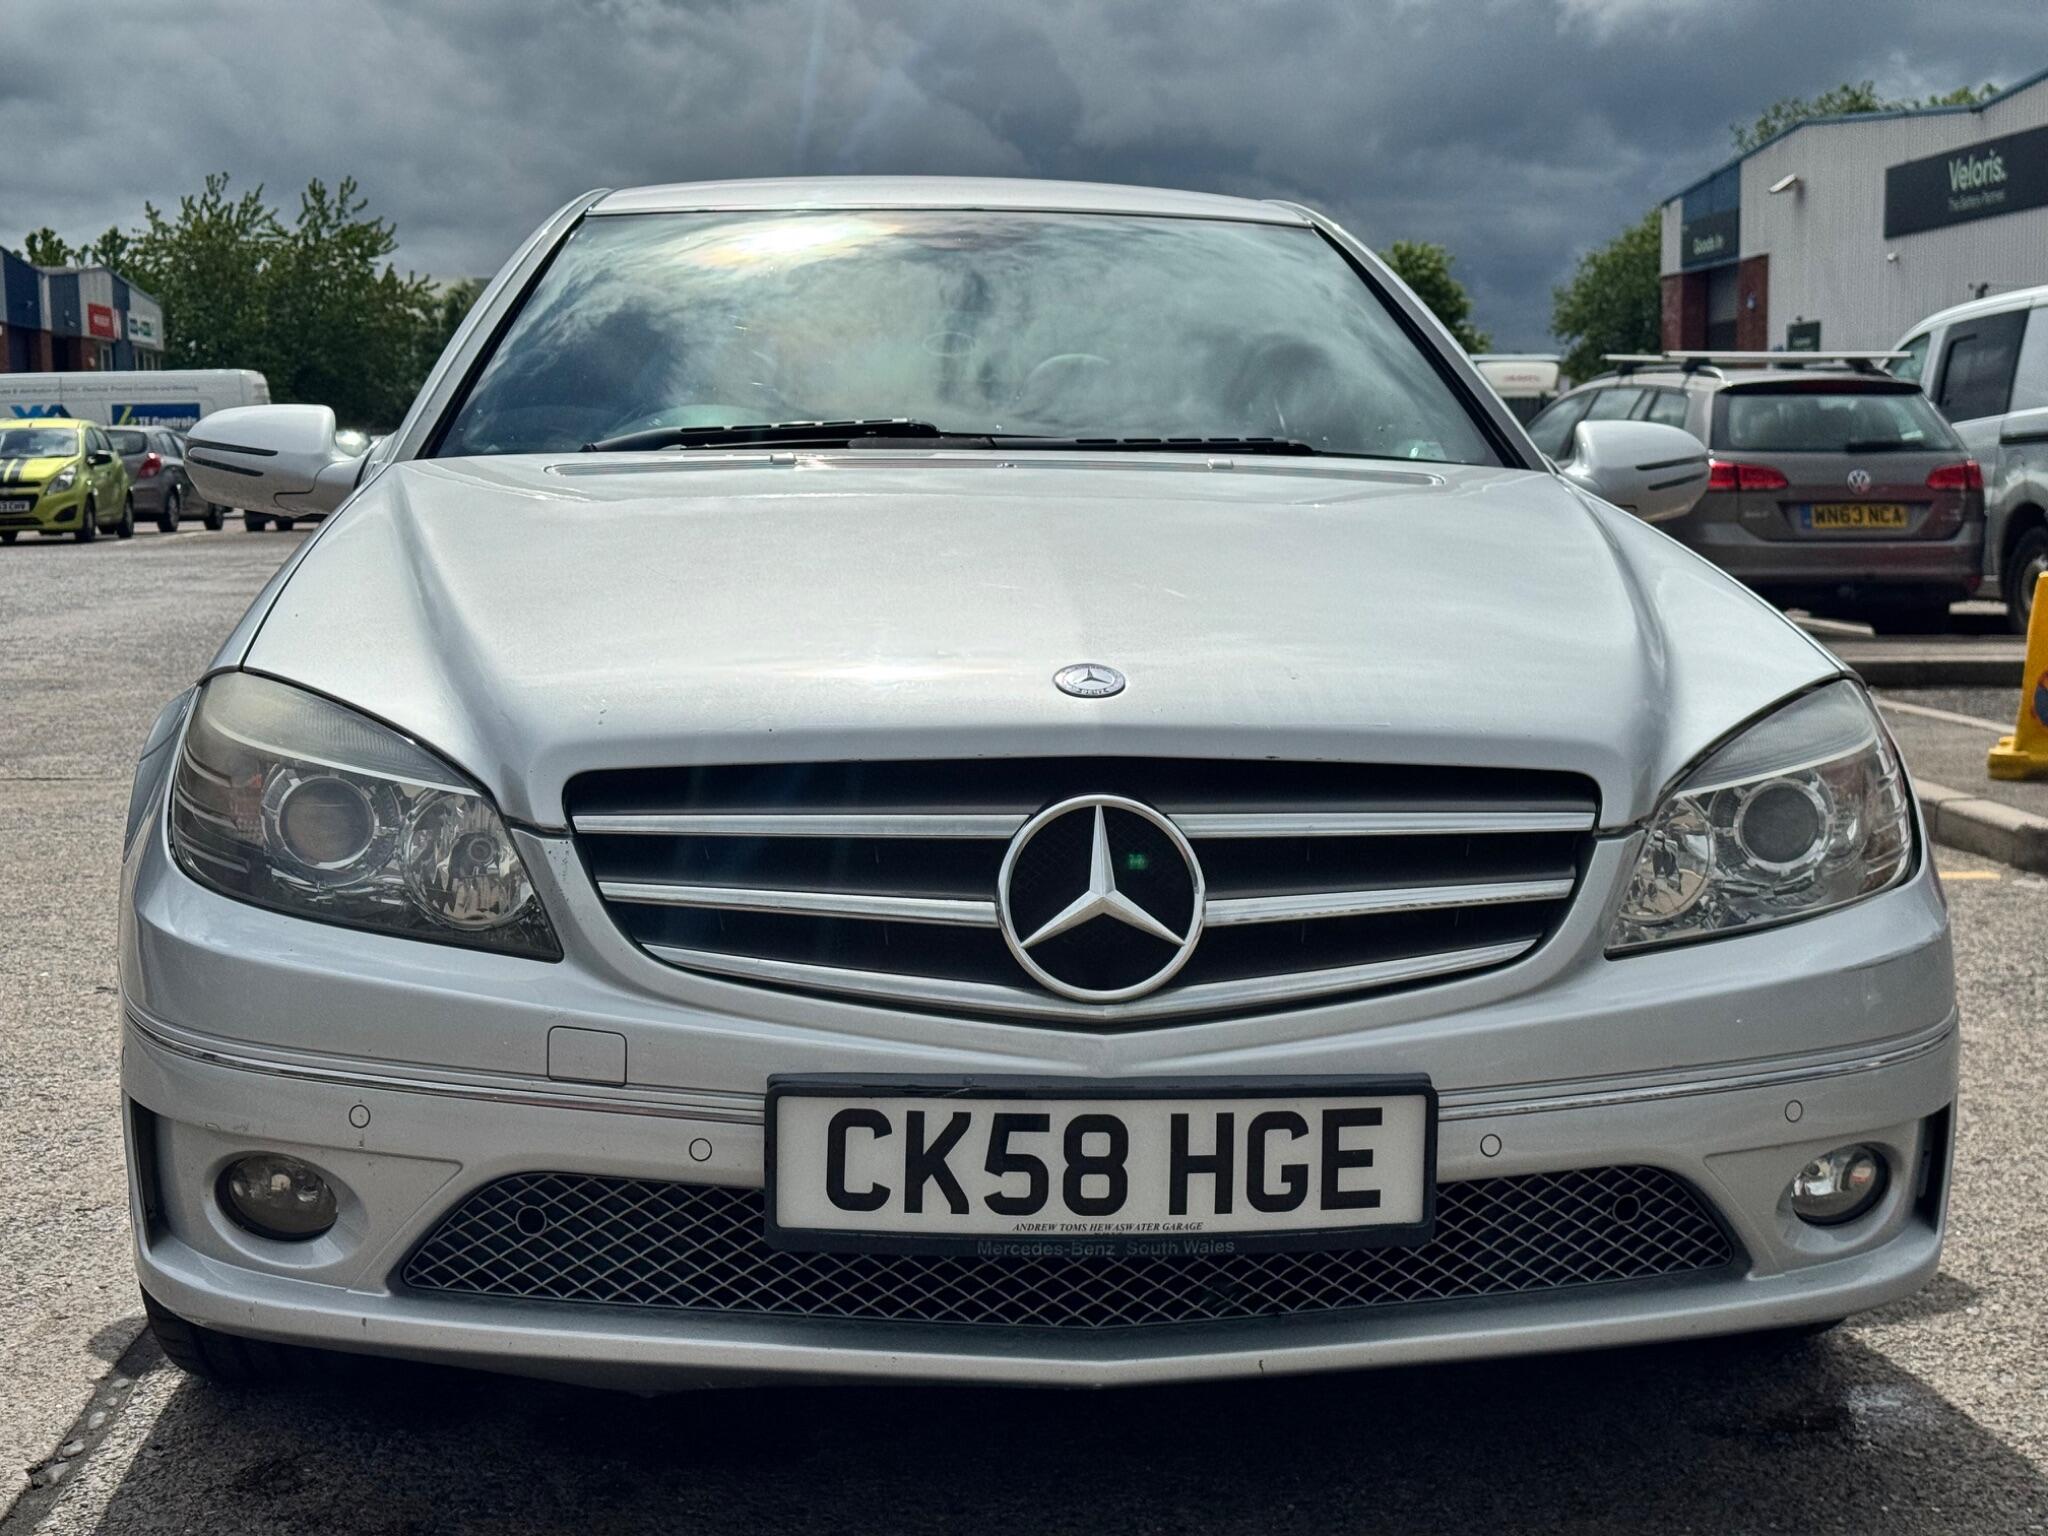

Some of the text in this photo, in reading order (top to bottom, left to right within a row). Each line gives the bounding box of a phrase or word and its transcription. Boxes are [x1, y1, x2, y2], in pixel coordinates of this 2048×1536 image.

[1815, 506, 1903, 524] WN63 NCA
[826, 1107, 1384, 1217] CK58 HGE
[1013, 1221, 1204, 1232] ANDREW TOMS HEWASWATER GARAGE
[977, 1239, 1236, 1256] Mercedes-Benz South Wales
